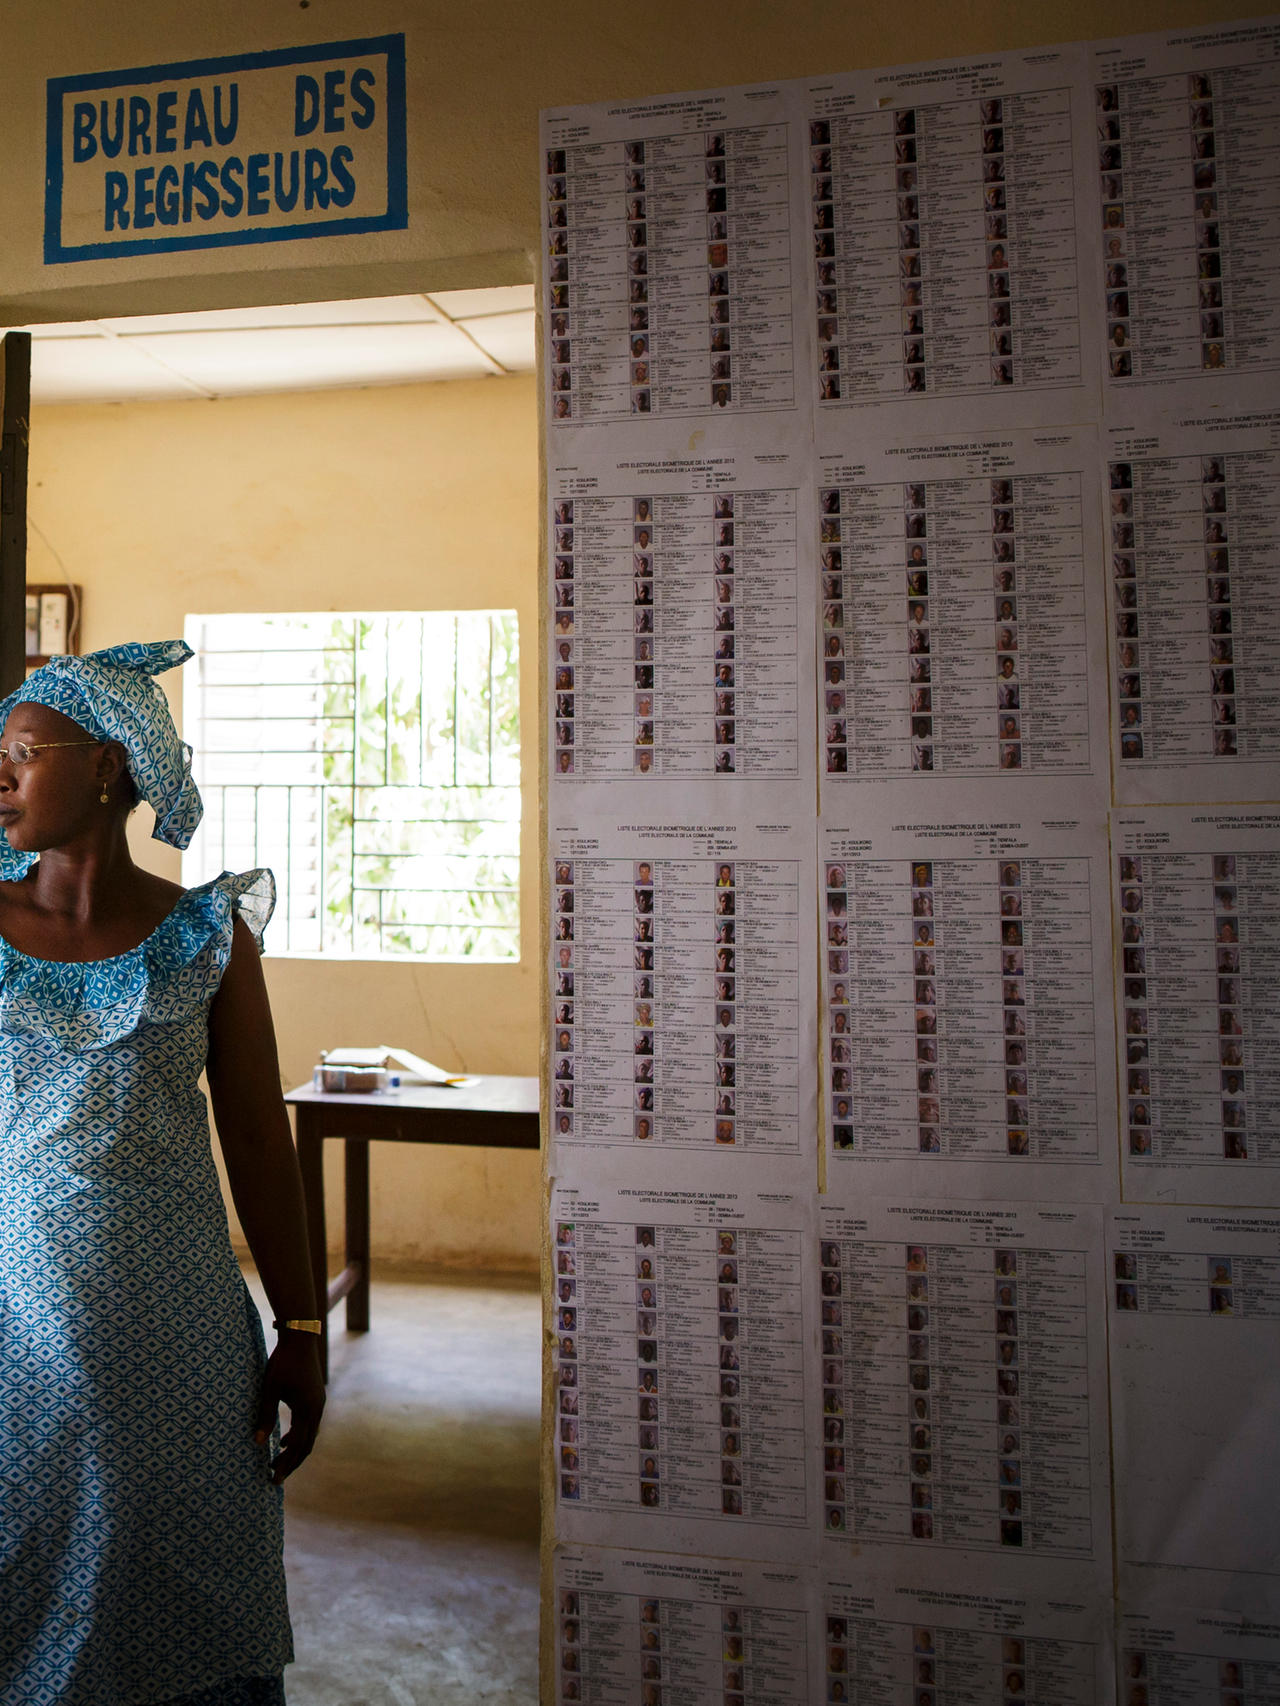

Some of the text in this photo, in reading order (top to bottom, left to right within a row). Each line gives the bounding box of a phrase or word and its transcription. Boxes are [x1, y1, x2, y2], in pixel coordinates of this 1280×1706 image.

[73, 68, 376, 163] BUREAU DES
[105, 145, 356, 231] REGISSEURS
